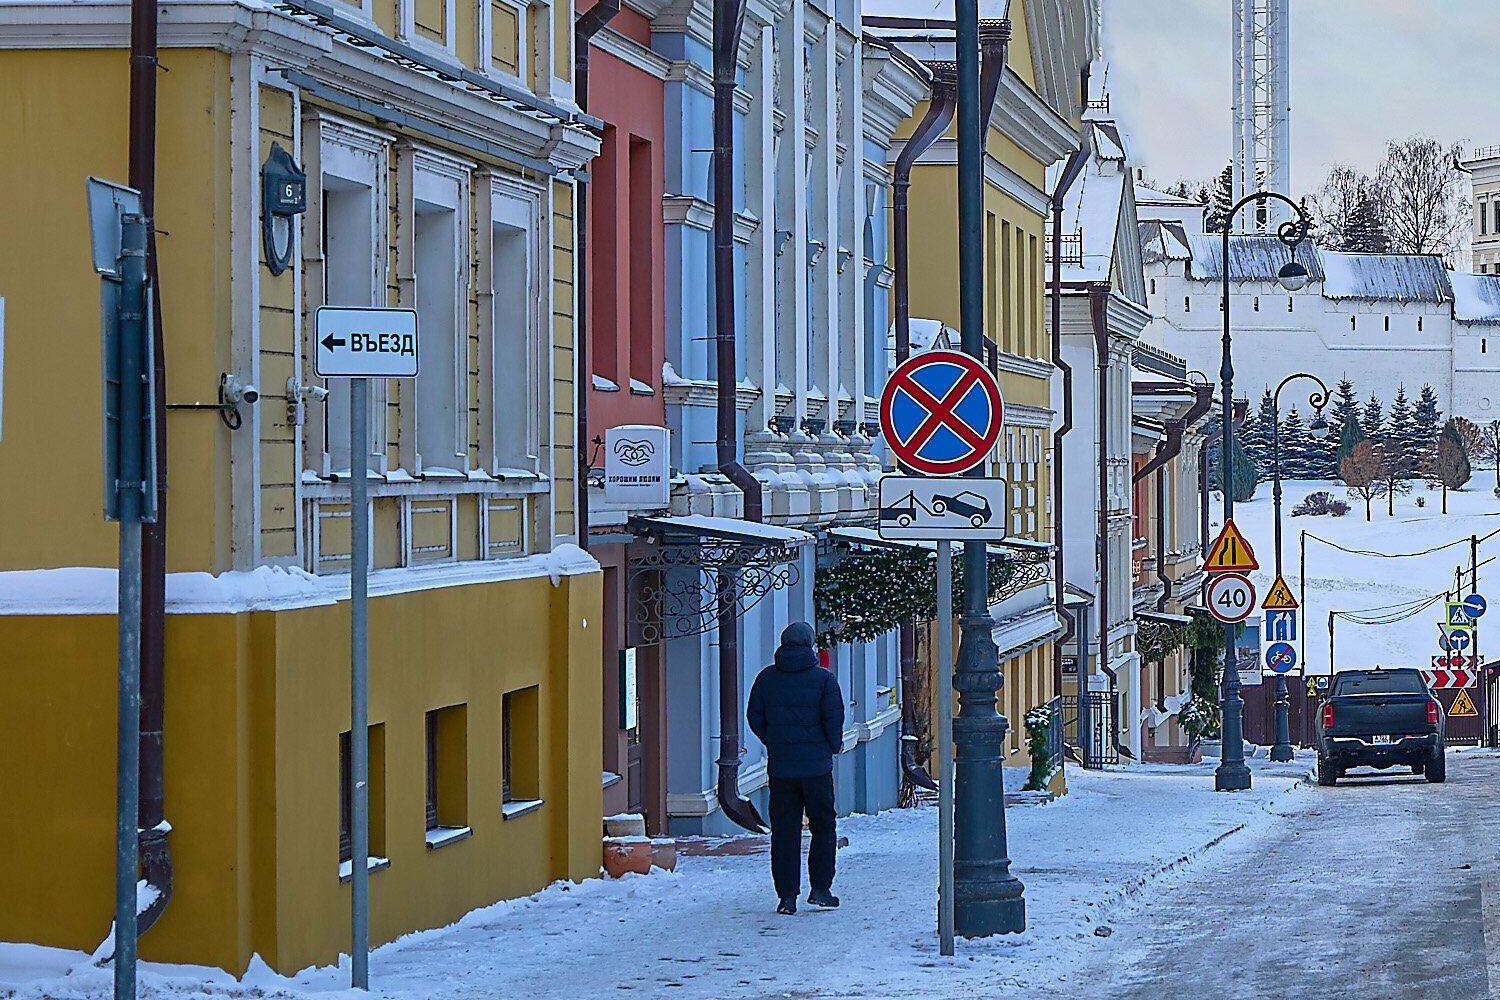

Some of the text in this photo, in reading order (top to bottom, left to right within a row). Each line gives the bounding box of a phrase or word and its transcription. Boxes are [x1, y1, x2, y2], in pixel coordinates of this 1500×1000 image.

[285, 184, 293, 198] 6
[351, 333, 414, 356] ВЪЕЗД
[1218, 589, 1246, 607] 40
